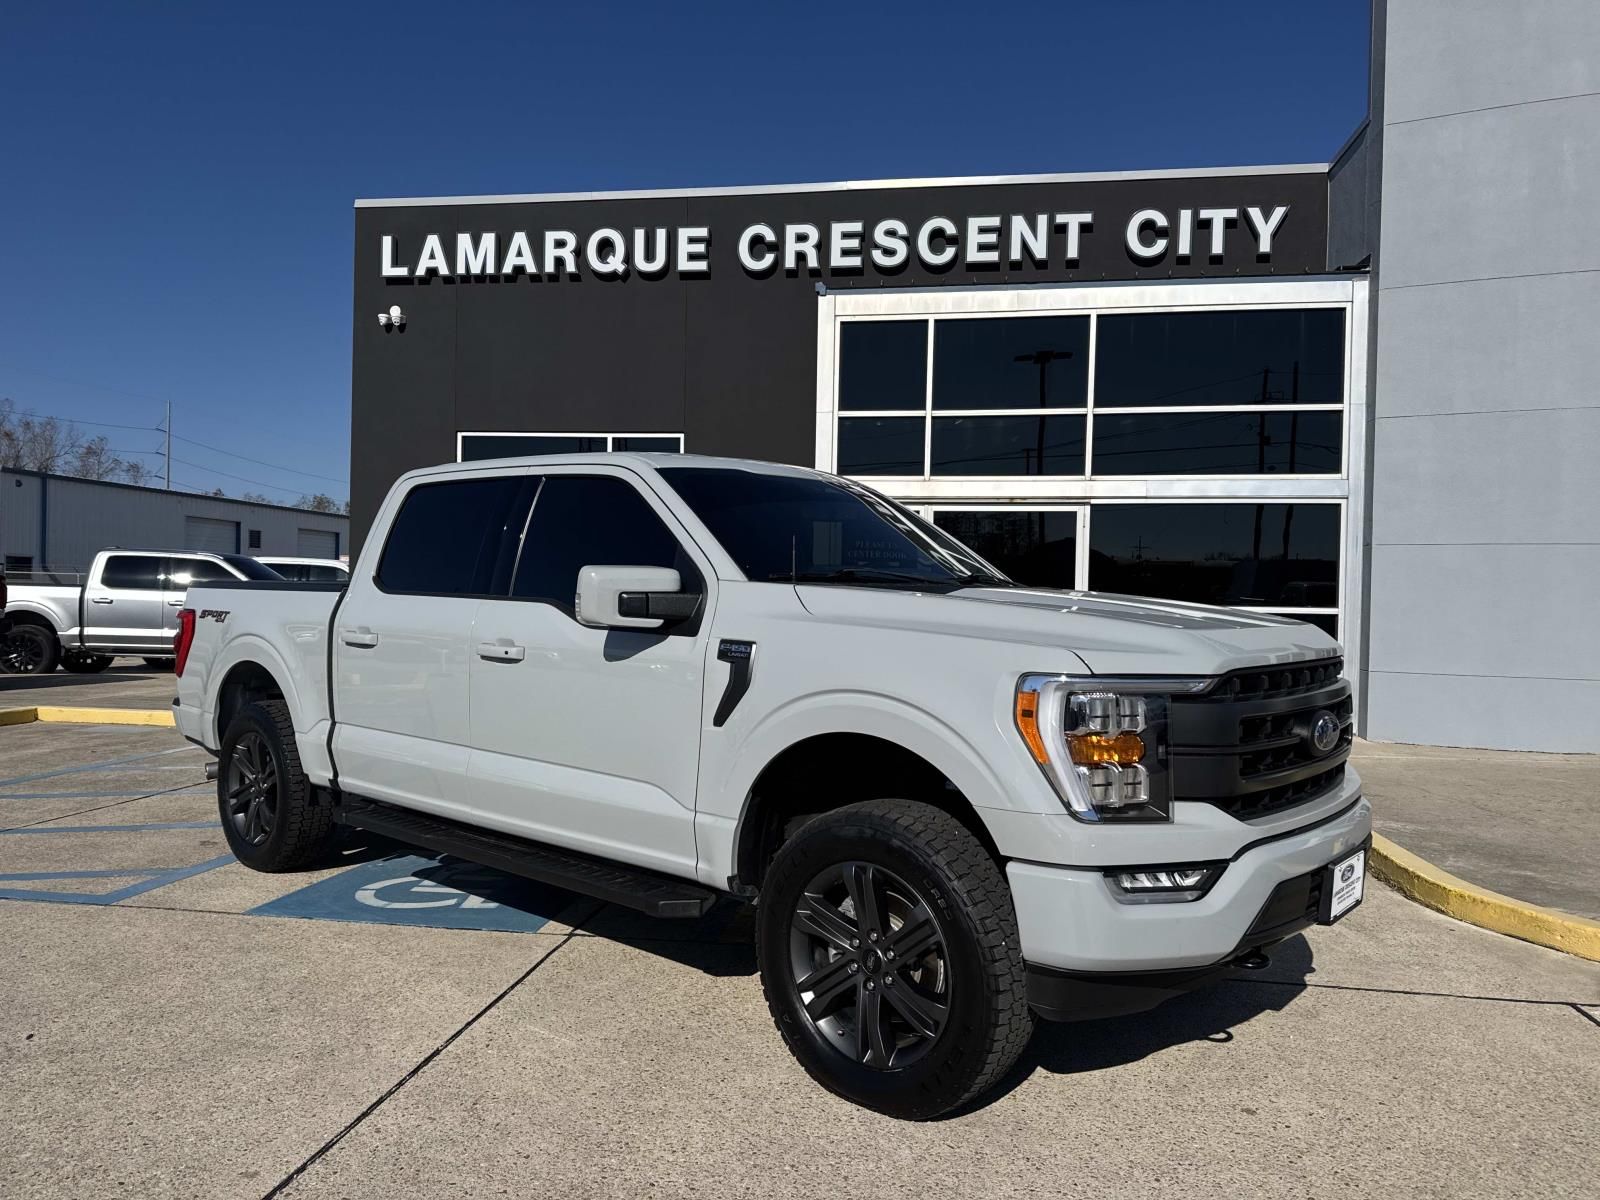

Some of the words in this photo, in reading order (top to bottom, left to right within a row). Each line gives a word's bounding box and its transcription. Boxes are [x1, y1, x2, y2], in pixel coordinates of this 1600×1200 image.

[381, 227, 709, 277] LAMARQUE
[738, 212, 1093, 271] CRESCENT
[1126, 205, 1288, 258] CITY
[199, 609, 231, 621] SPORT
